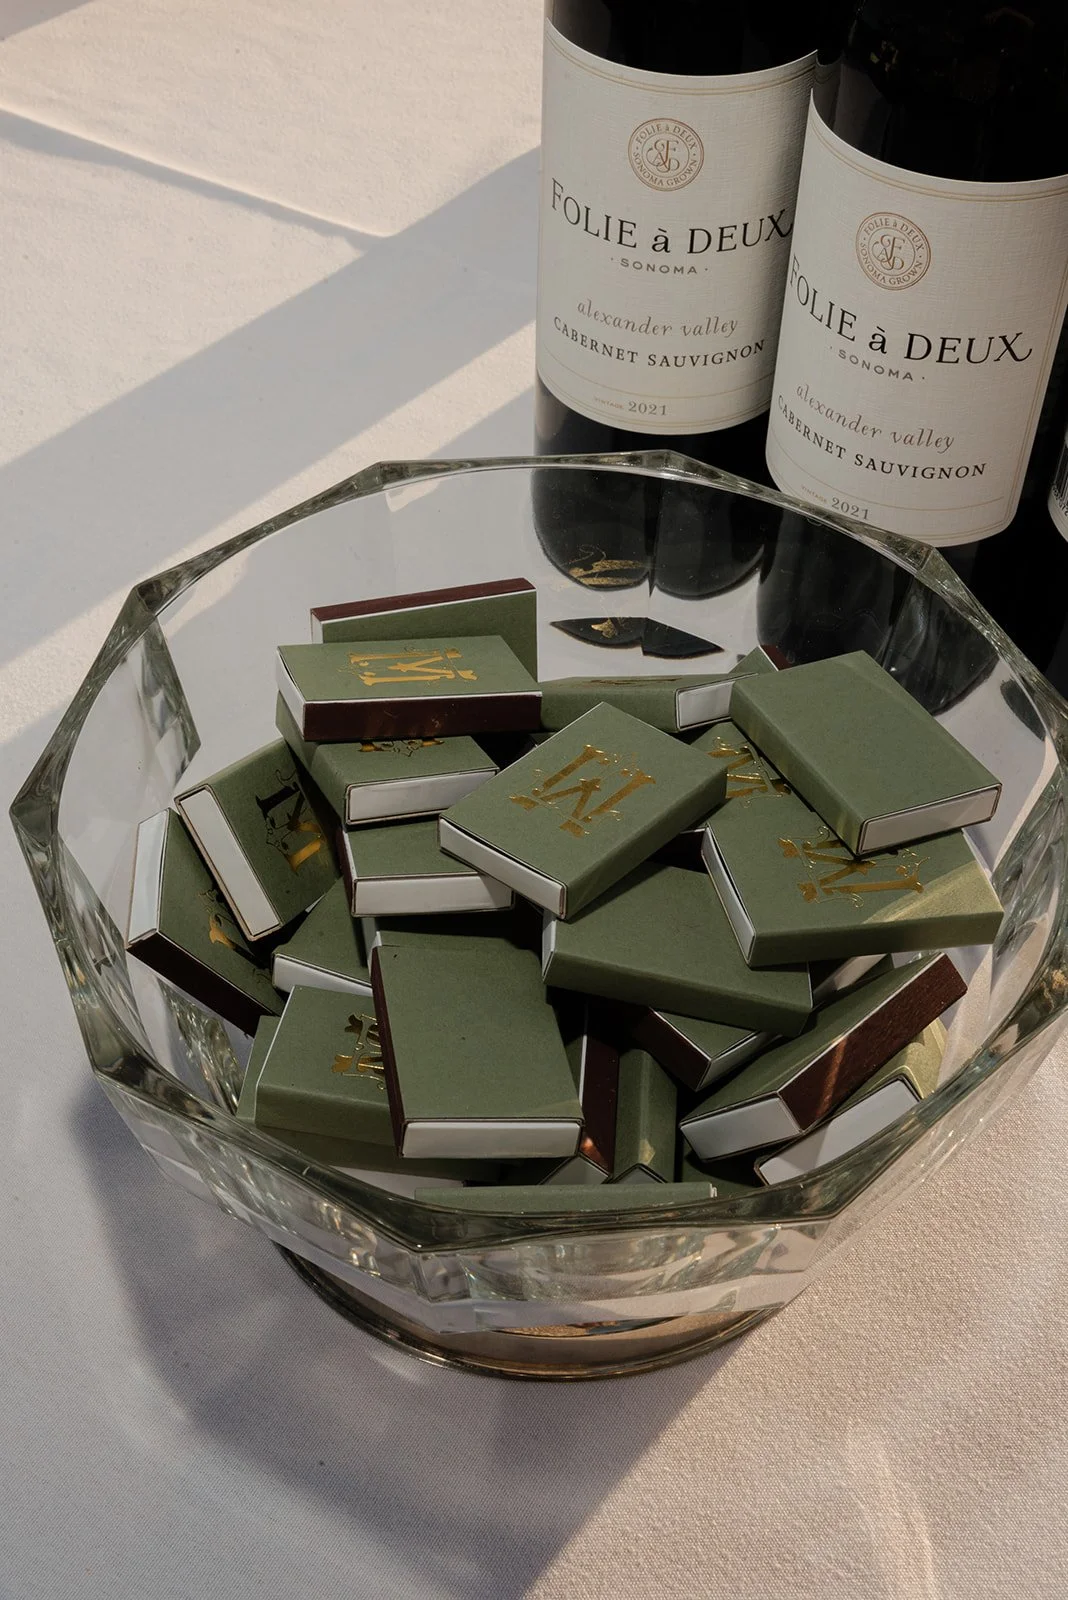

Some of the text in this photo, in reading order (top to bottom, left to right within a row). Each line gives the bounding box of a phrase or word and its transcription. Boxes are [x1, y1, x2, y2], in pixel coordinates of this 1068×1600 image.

[636, 123, 662, 144] FOLIE
[673, 125, 698, 150] DEUX
[633, 151, 664, 186] SONOMA
[666, 159, 698, 186] GROWN
[551, 177, 793, 254] FOLIE à DEUX
[863, 217, 890, 236] FOLIE
[900, 223, 925, 252] DEUX
[619, 257, 698, 275] SONOMA
[860, 242, 887, 284] SONOMA
[888, 260, 923, 286] GROWN
[576, 298, 739, 338] alexander valley
[789, 252, 857, 342] FOLIE
[868, 326, 888, 354] à
[904, 331, 1033, 365] DEUX
[553, 316, 766, 368] CABERNET SAUVIGNON
[837, 348, 914, 382] SONOMA
[628, 400, 667, 416] 2021
[795, 383, 955, 454] alexander valley
[777, 394, 988, 480] CABERNET SAUVIGNON
[831, 496, 869, 520] 2021
